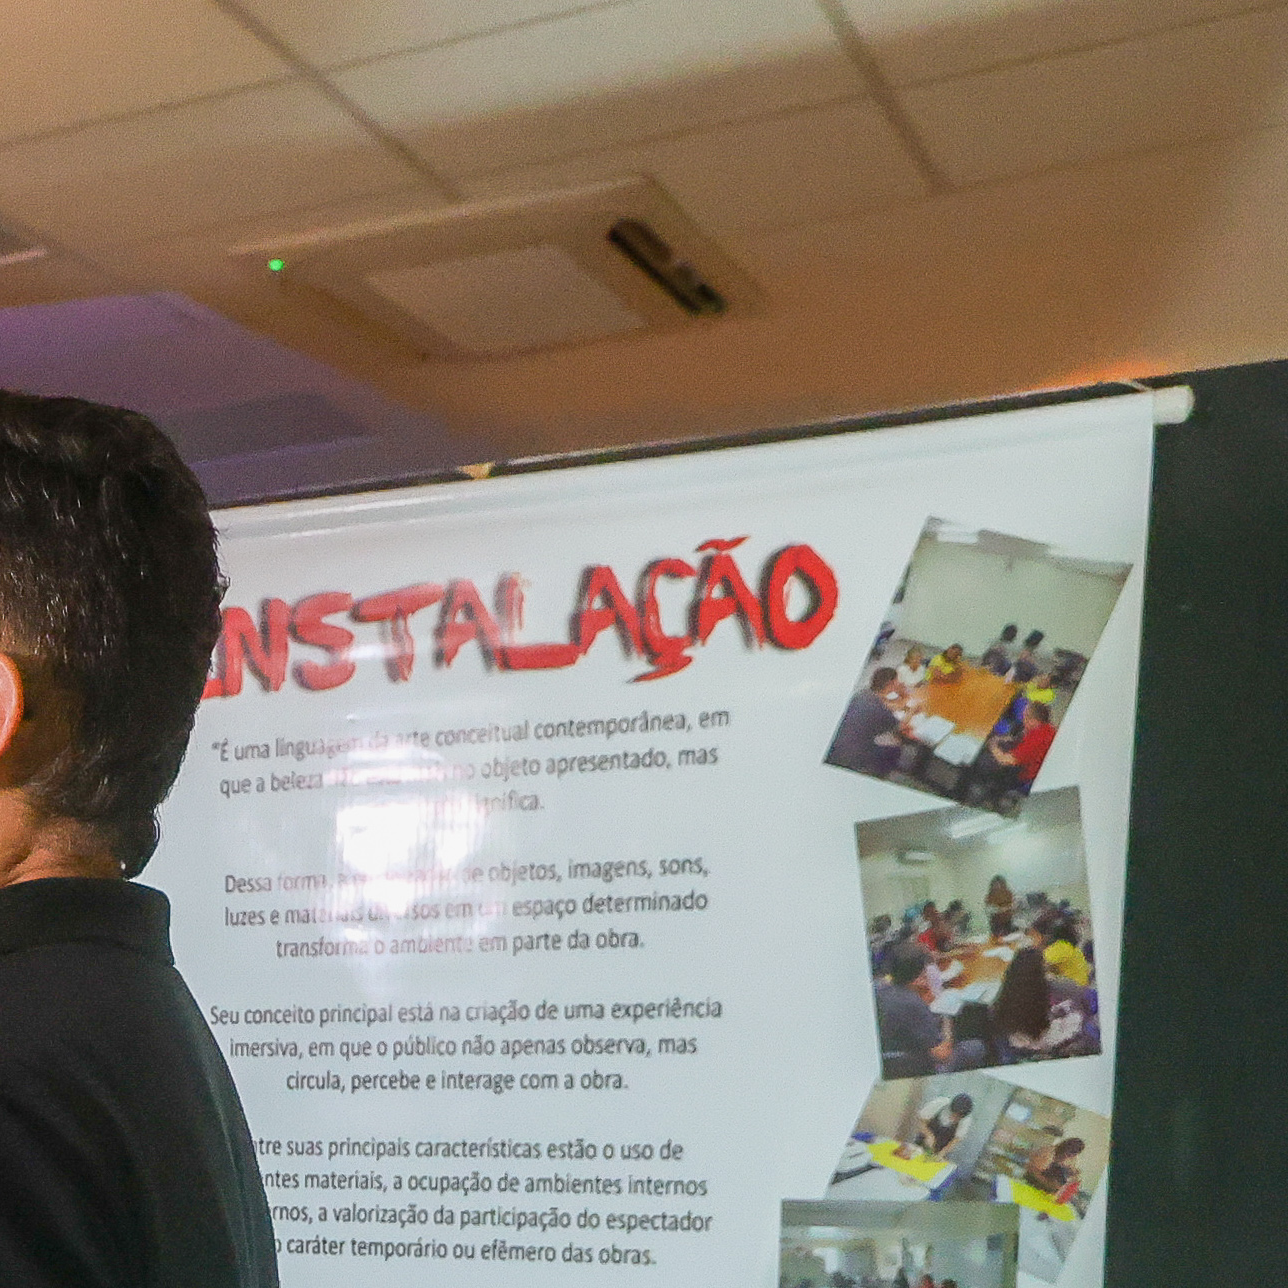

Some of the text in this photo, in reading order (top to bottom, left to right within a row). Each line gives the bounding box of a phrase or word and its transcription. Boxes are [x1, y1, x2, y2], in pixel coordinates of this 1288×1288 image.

[200, 534, 840, 702] NSTALAÇÃO
[210, 997, 722, 1028] Seu conceito principal está na criação de uma experiência
[230, 1035, 698, 1061] imersiva, em que o público não apenas observa, mas
[286, 1069, 629, 1095] circula, percebe e interage com a obra.
[287, 1136, 684, 1161] suas principais características estão o uso de
[304, 1170, 708, 1196] materiais, a ocupação de ambientes internos
[318, 1202, 714, 1234] a valorização da participação do espectador
[286, 1235, 658, 1266] caráter temporário ou efêmero das obras.
